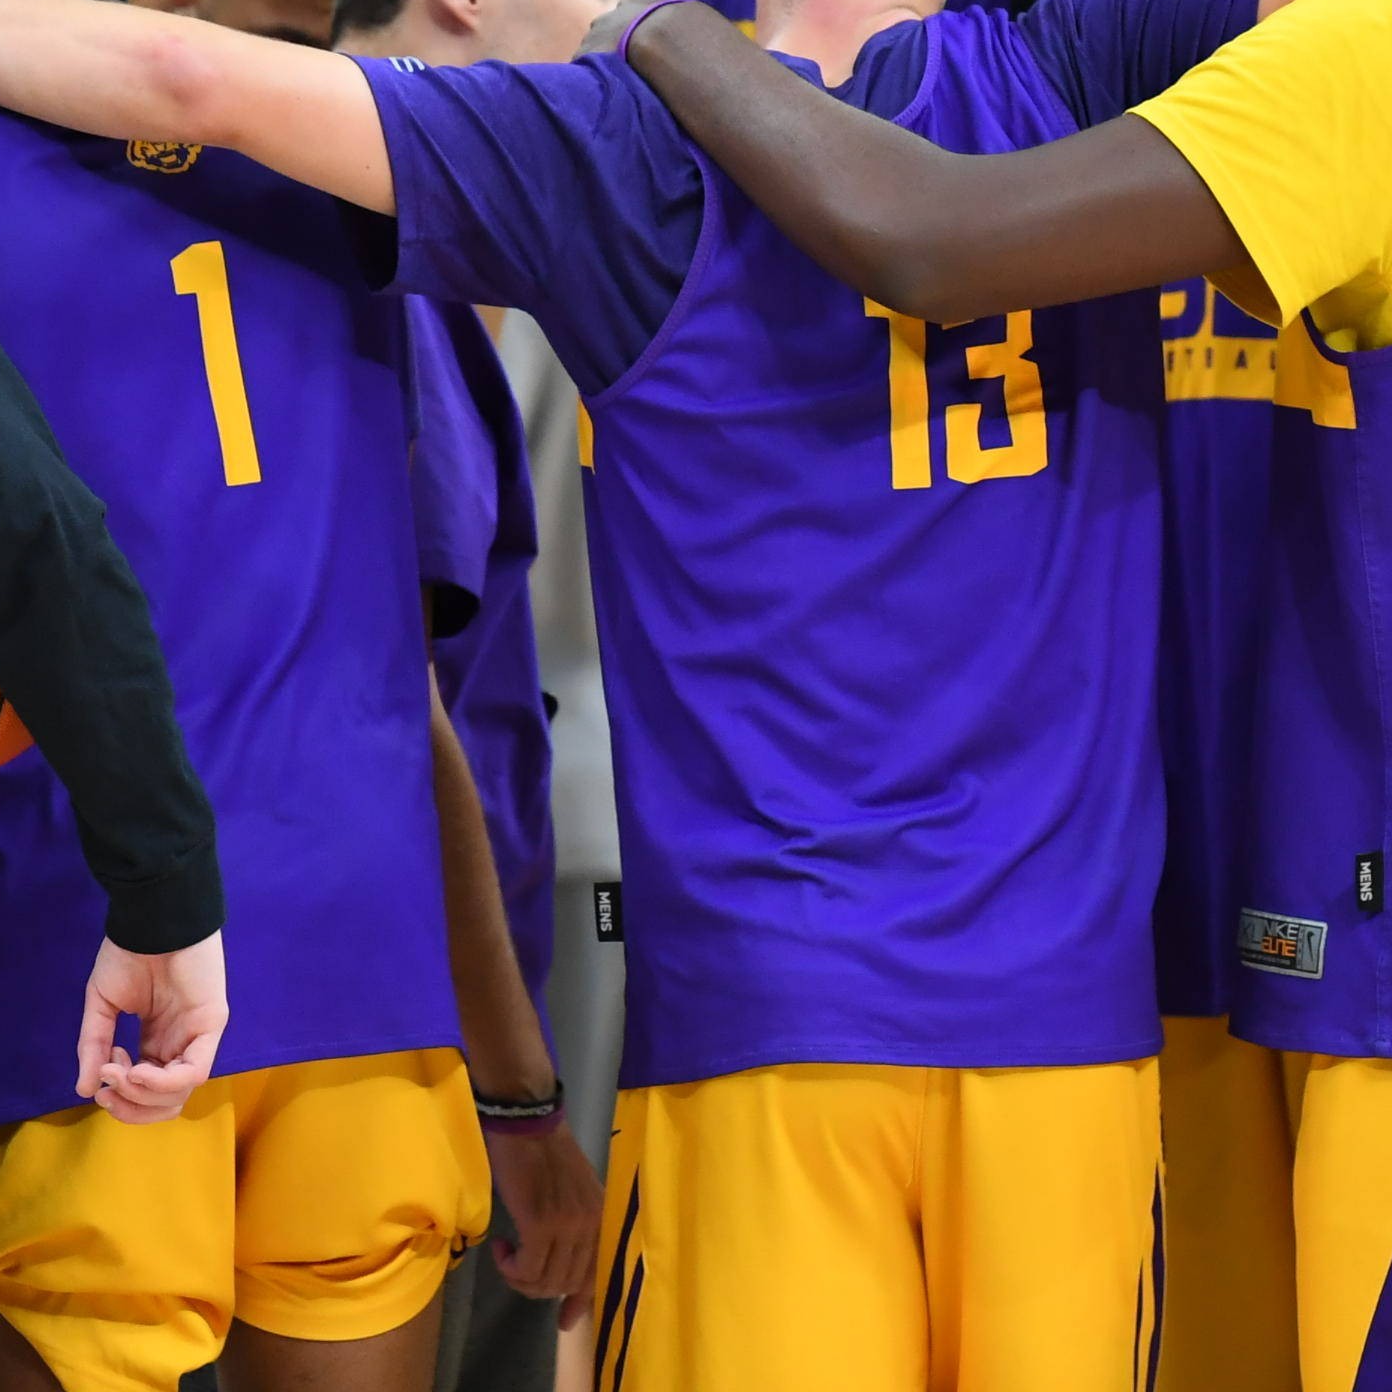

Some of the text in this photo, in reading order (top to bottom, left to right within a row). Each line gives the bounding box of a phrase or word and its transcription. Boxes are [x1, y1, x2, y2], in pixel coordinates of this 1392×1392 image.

[170, 240, 261, 486] 1
[863, 295, 1049, 490] 13
[597, 891, 613, 932] MENS
[1359, 861, 1374, 902] MENS
